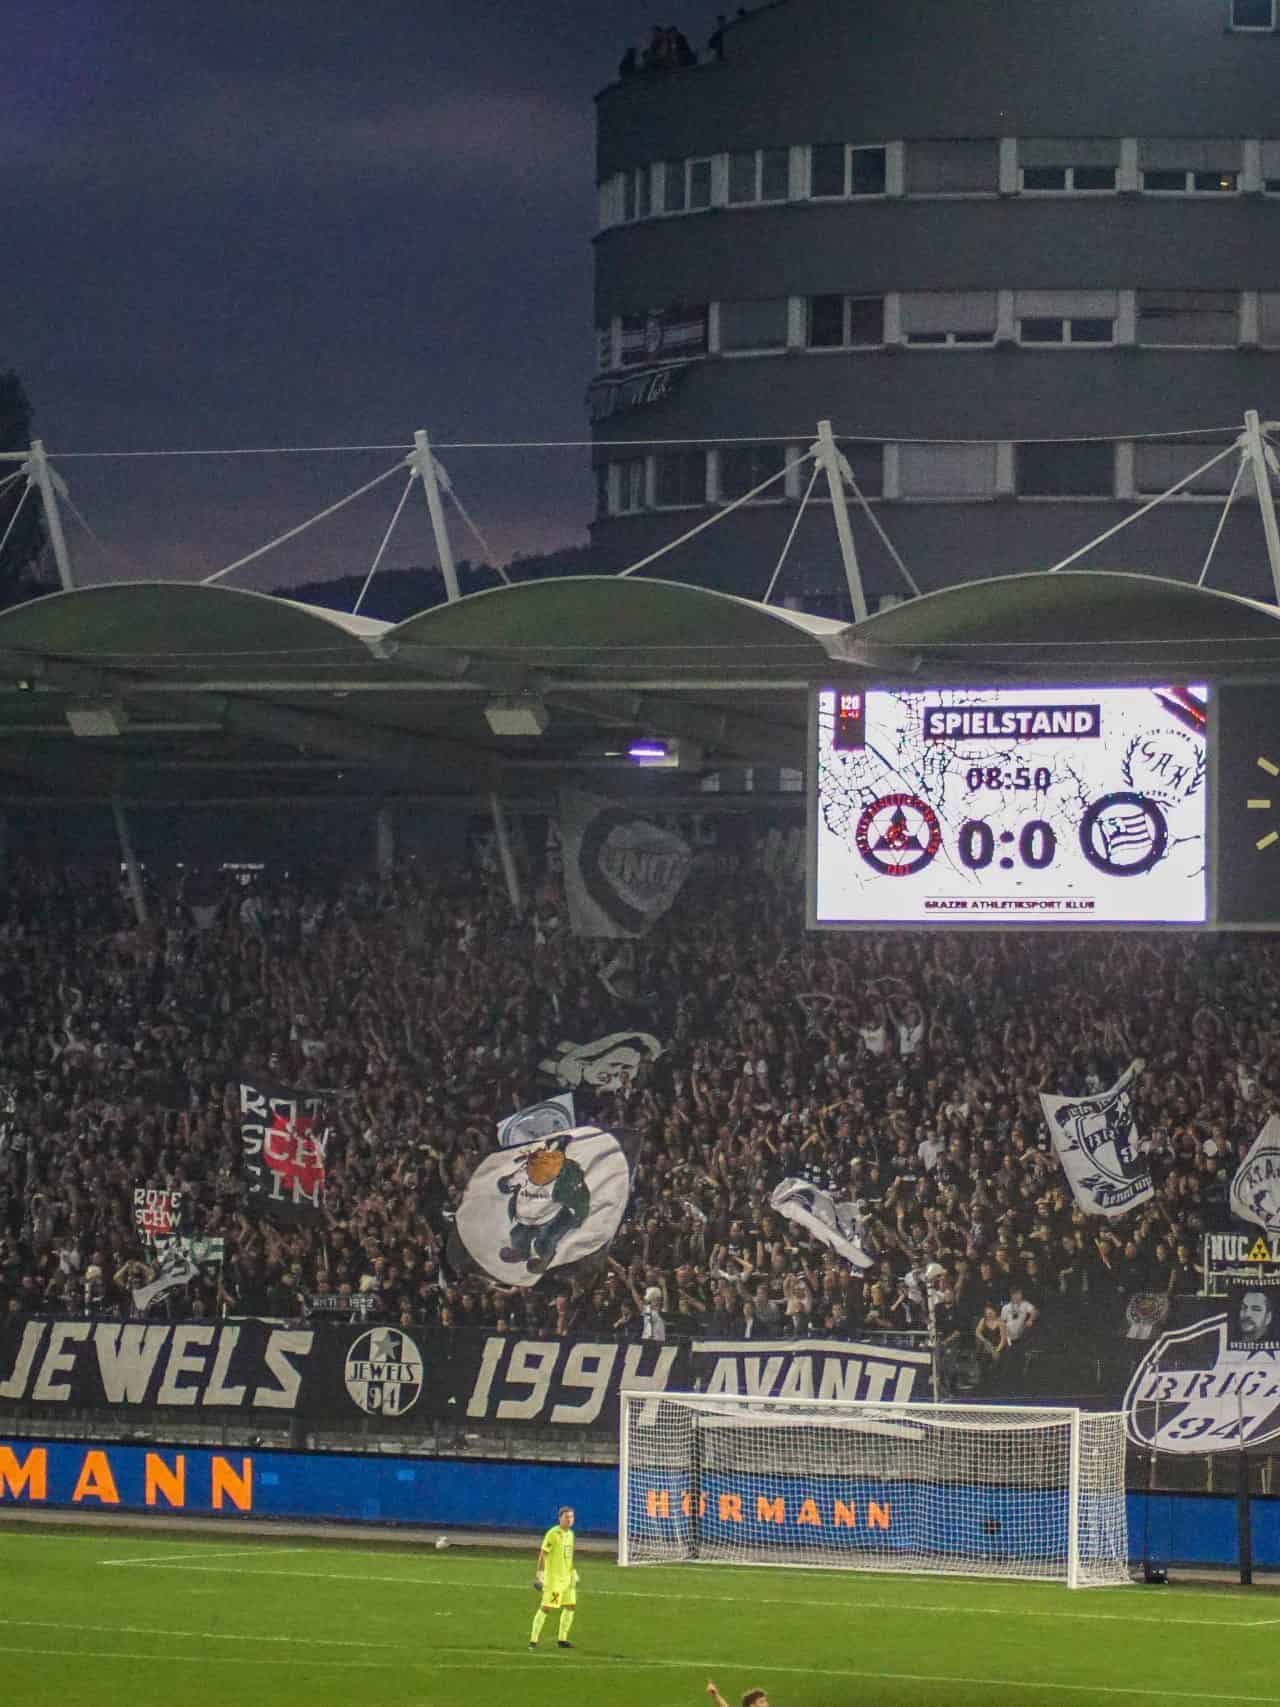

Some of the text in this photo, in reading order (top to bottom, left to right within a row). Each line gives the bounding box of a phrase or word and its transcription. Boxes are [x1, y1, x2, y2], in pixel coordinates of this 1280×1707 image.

[929, 711, 1093, 735] SPIELSTAND
[966, 767, 1051, 790] 08:50
[958, 819, 1056, 869] 0:0
[134, 1188, 182, 1210] ROTE
[135, 1209, 182, 1229] SCHW
[0, 1320, 315, 1409] JEWELS
[350, 1363, 414, 1382] JEWELS
[466, 1337, 678, 1425] 1994
[705, 1355, 916, 1411] AVANTI
[1168, 1414, 1256, 1440] 94
